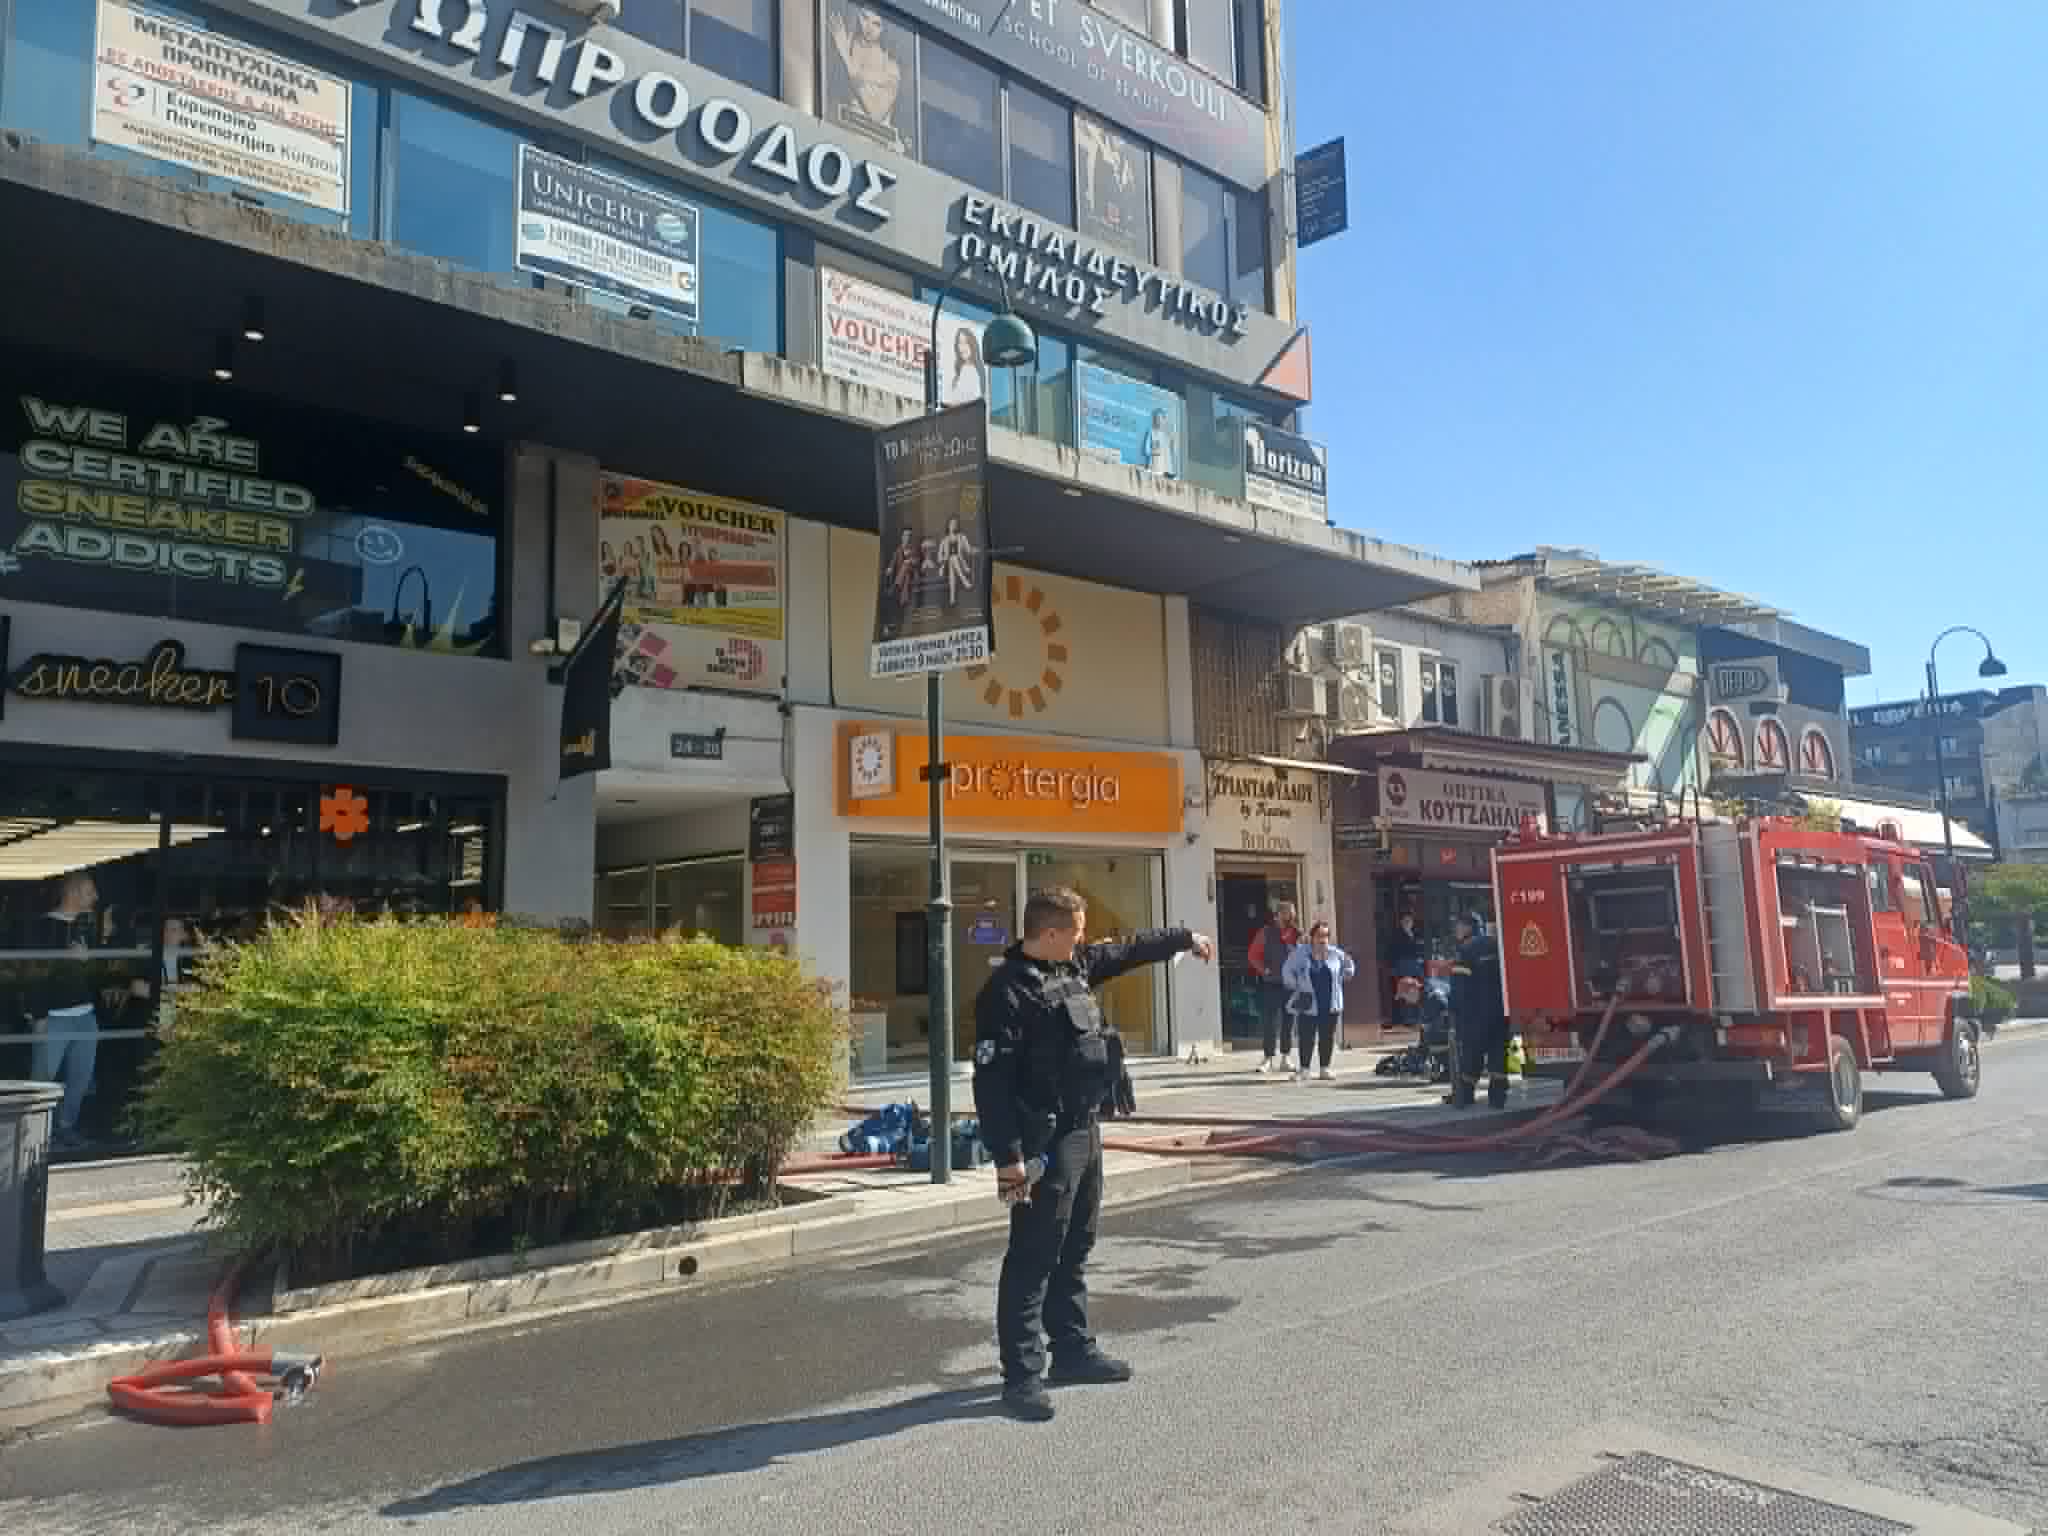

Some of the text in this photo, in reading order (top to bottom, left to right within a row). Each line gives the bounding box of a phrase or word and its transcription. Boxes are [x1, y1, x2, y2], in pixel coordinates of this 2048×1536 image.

[133, 16, 320, 95] ΜΕΤΑΠΤΥΧΙΑΚΑ
[162, 44, 300, 105] ΠΡΟΠΤΥΧΙΑΚΑ
[1002, 15, 1078, 69] SCHOOL
[1079, 14, 1228, 121] SVERKOULI
[410, 0, 898, 218] ΩΠΡΟΟΔΟΣ
[532, 169, 649, 229] UNICERT
[958, 232, 1108, 316] ΟΜΙΛΟΣ
[961, 193, 1250, 335] ΕΚΠΑΙΔΕΥΤΙΚΟΣ
[827, 312, 928, 364] VOUCHE
[20, 396, 260, 473] WE ARE
[1247, 437, 1323, 483] Horizon
[19, 439, 315, 515] CERTIFIED
[17, 478, 293, 552] SNEAKER
[663, 495, 777, 536] VOUCHER
[17, 520, 288, 588] ADDICTS
[17, 645, 321, 714] sneaker 10
[951, 757, 1121, 809] protergia
